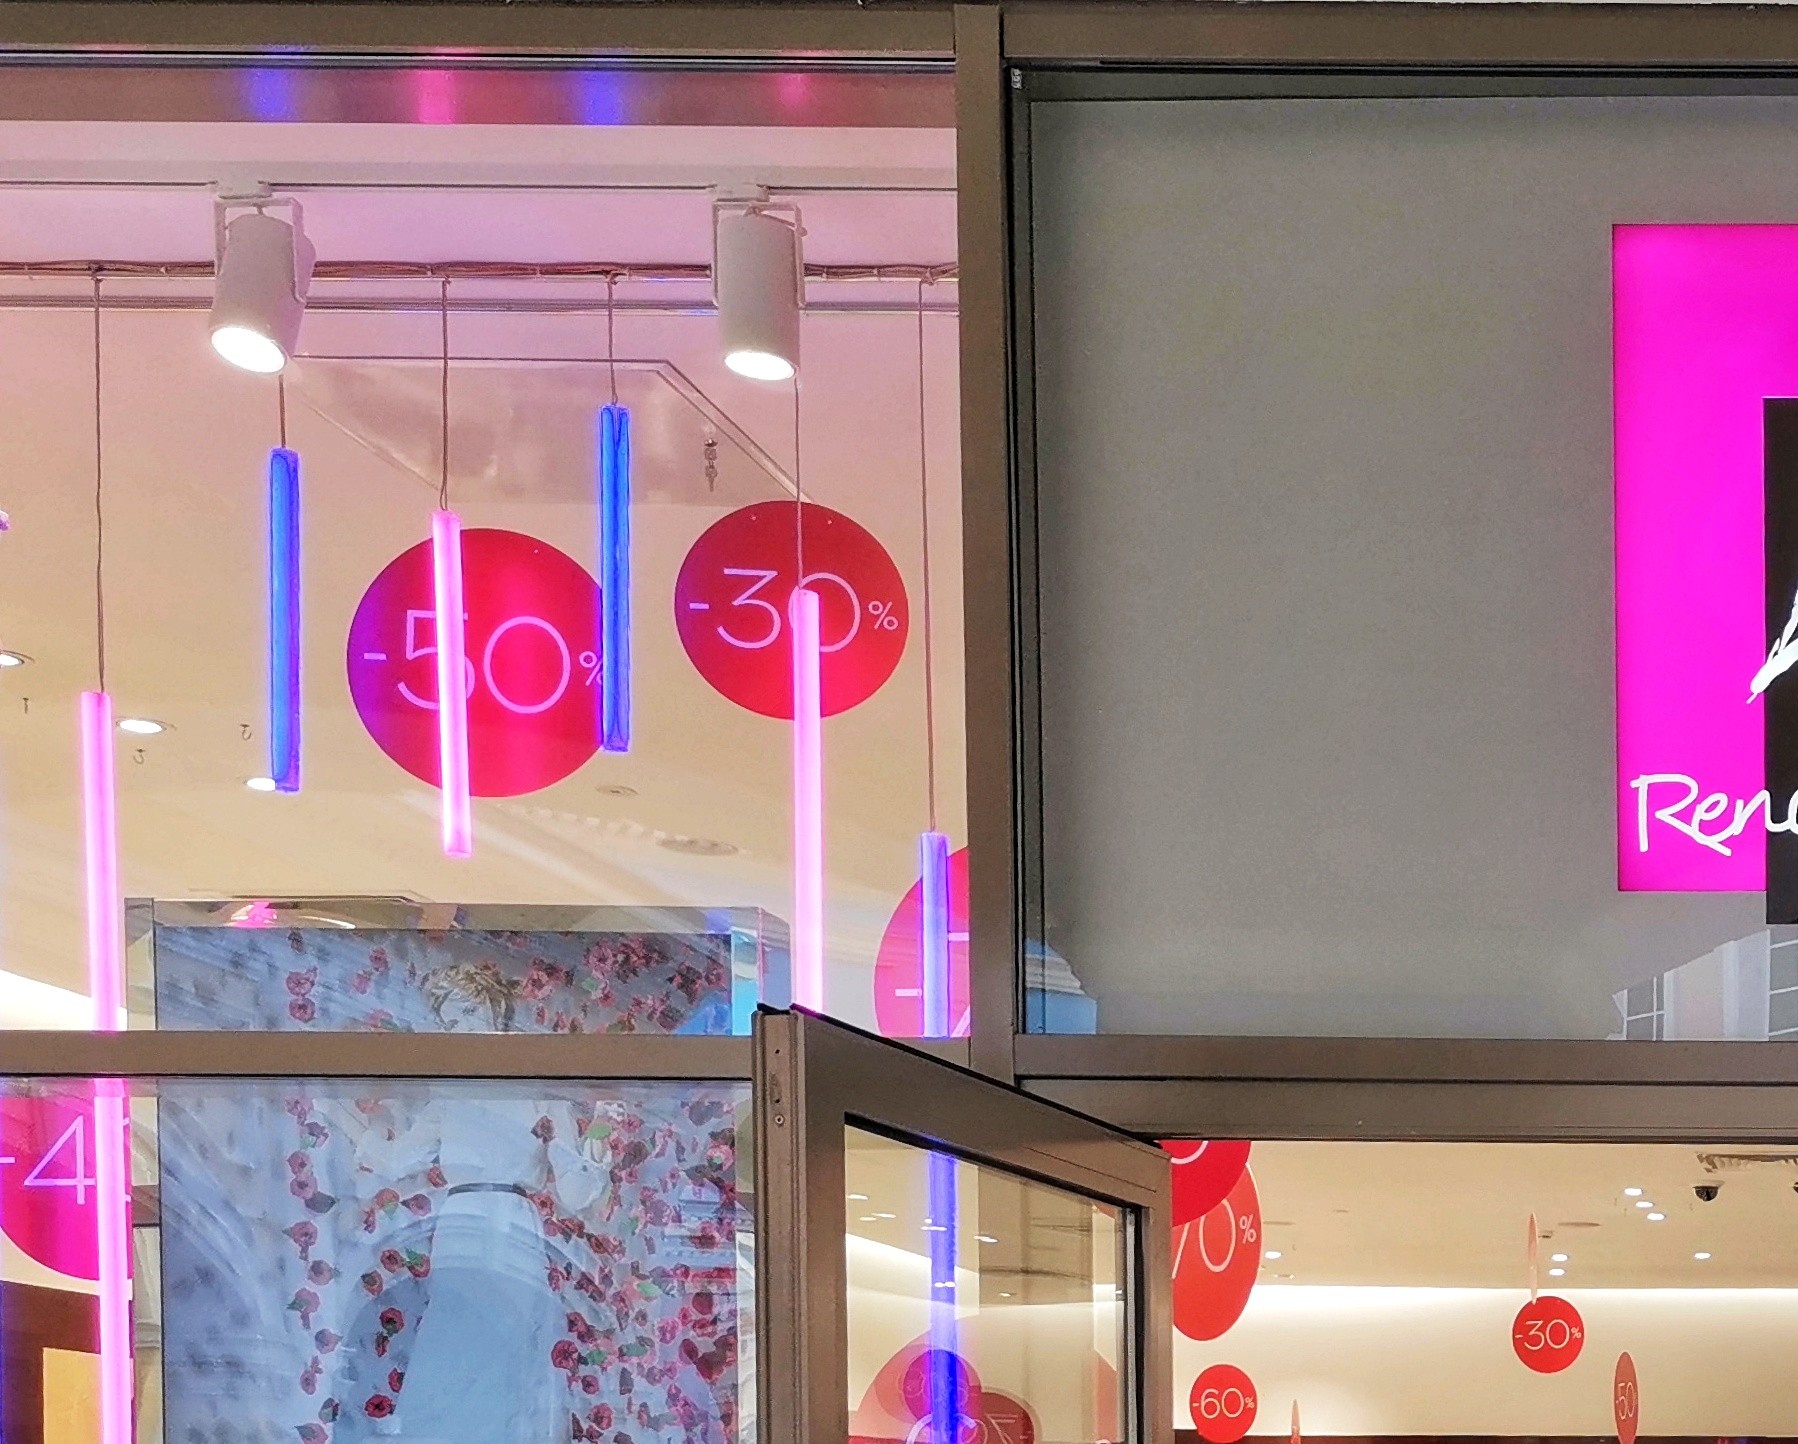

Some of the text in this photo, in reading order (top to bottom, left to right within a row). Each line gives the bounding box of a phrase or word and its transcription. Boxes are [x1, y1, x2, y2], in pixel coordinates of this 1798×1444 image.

[689, 568, 898, 652] -30%
[1515, 1319, 1582, 1350] -30%
[1192, 1387, 1255, 1419] -60%
